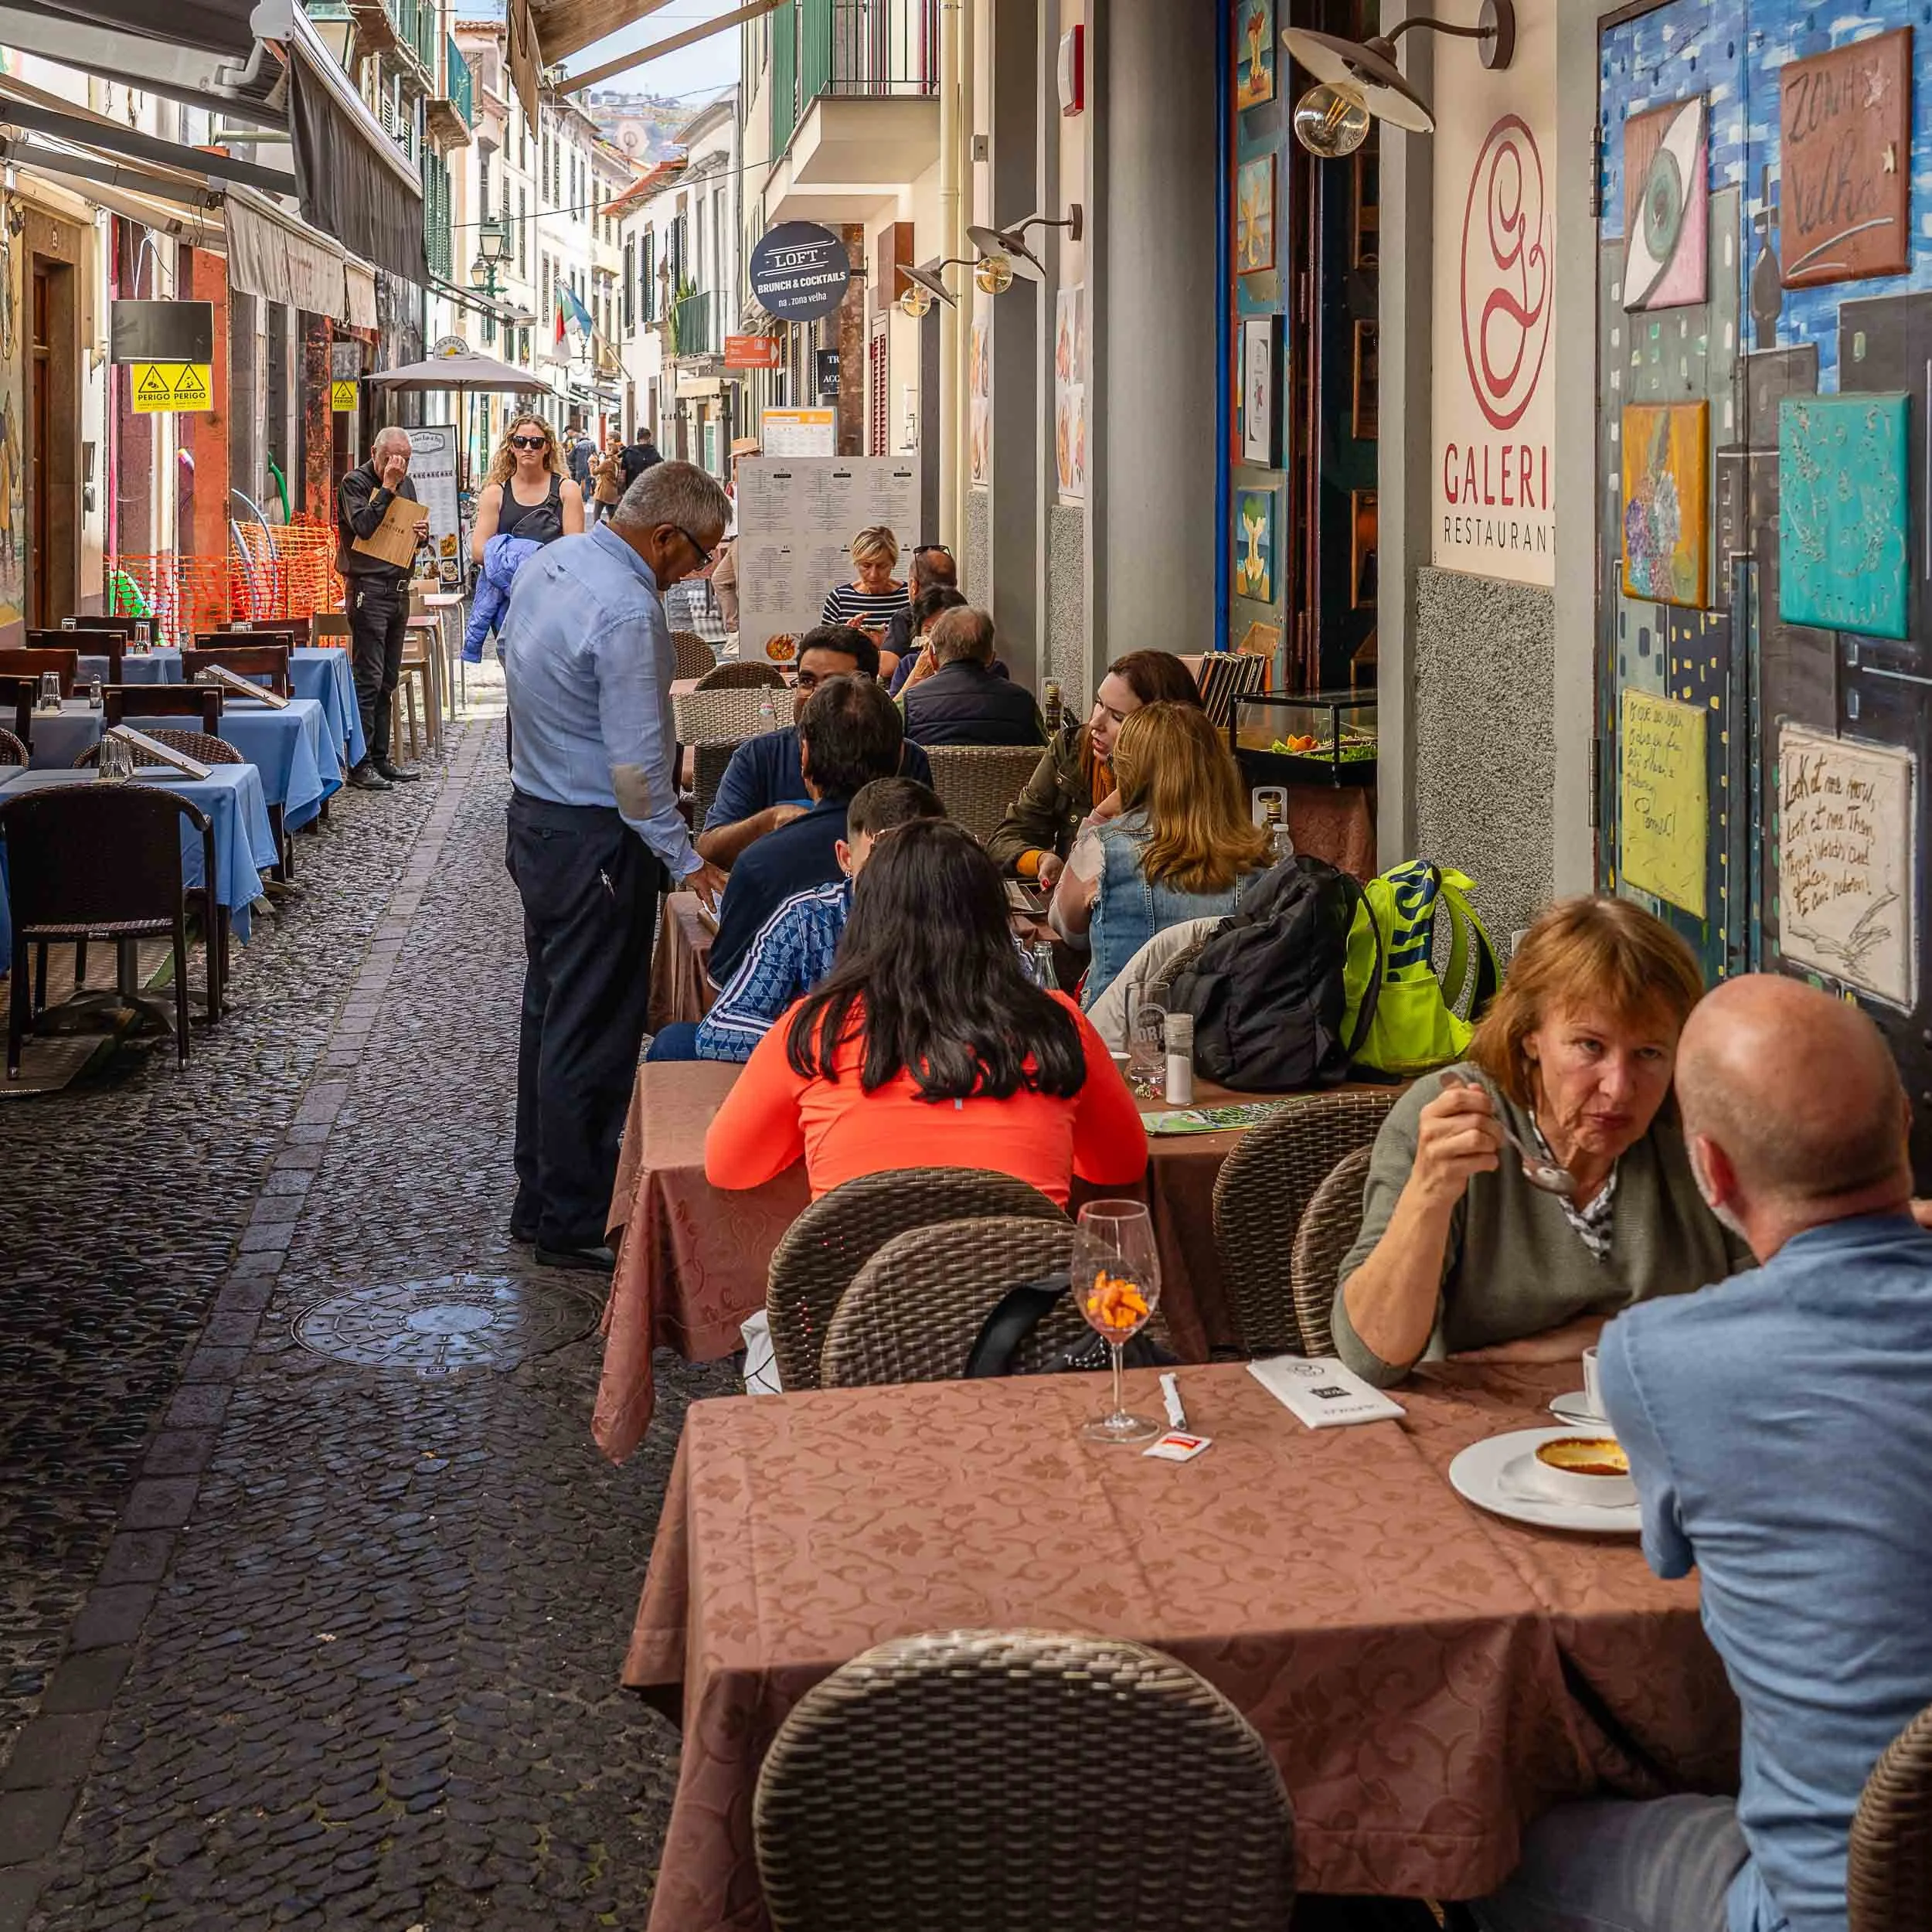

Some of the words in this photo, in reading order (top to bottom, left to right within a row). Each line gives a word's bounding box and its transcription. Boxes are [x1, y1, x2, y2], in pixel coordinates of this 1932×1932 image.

[774, 250, 818, 267] LOFT
[757, 280, 791, 294] BRUNCH
[792, 279, 799, 288] &
[800, 271, 846, 287] COCKTAILS
[791, 296, 808, 305] zona
[808, 291, 827, 302] velha
[1444, 443, 1549, 511] GALERI
